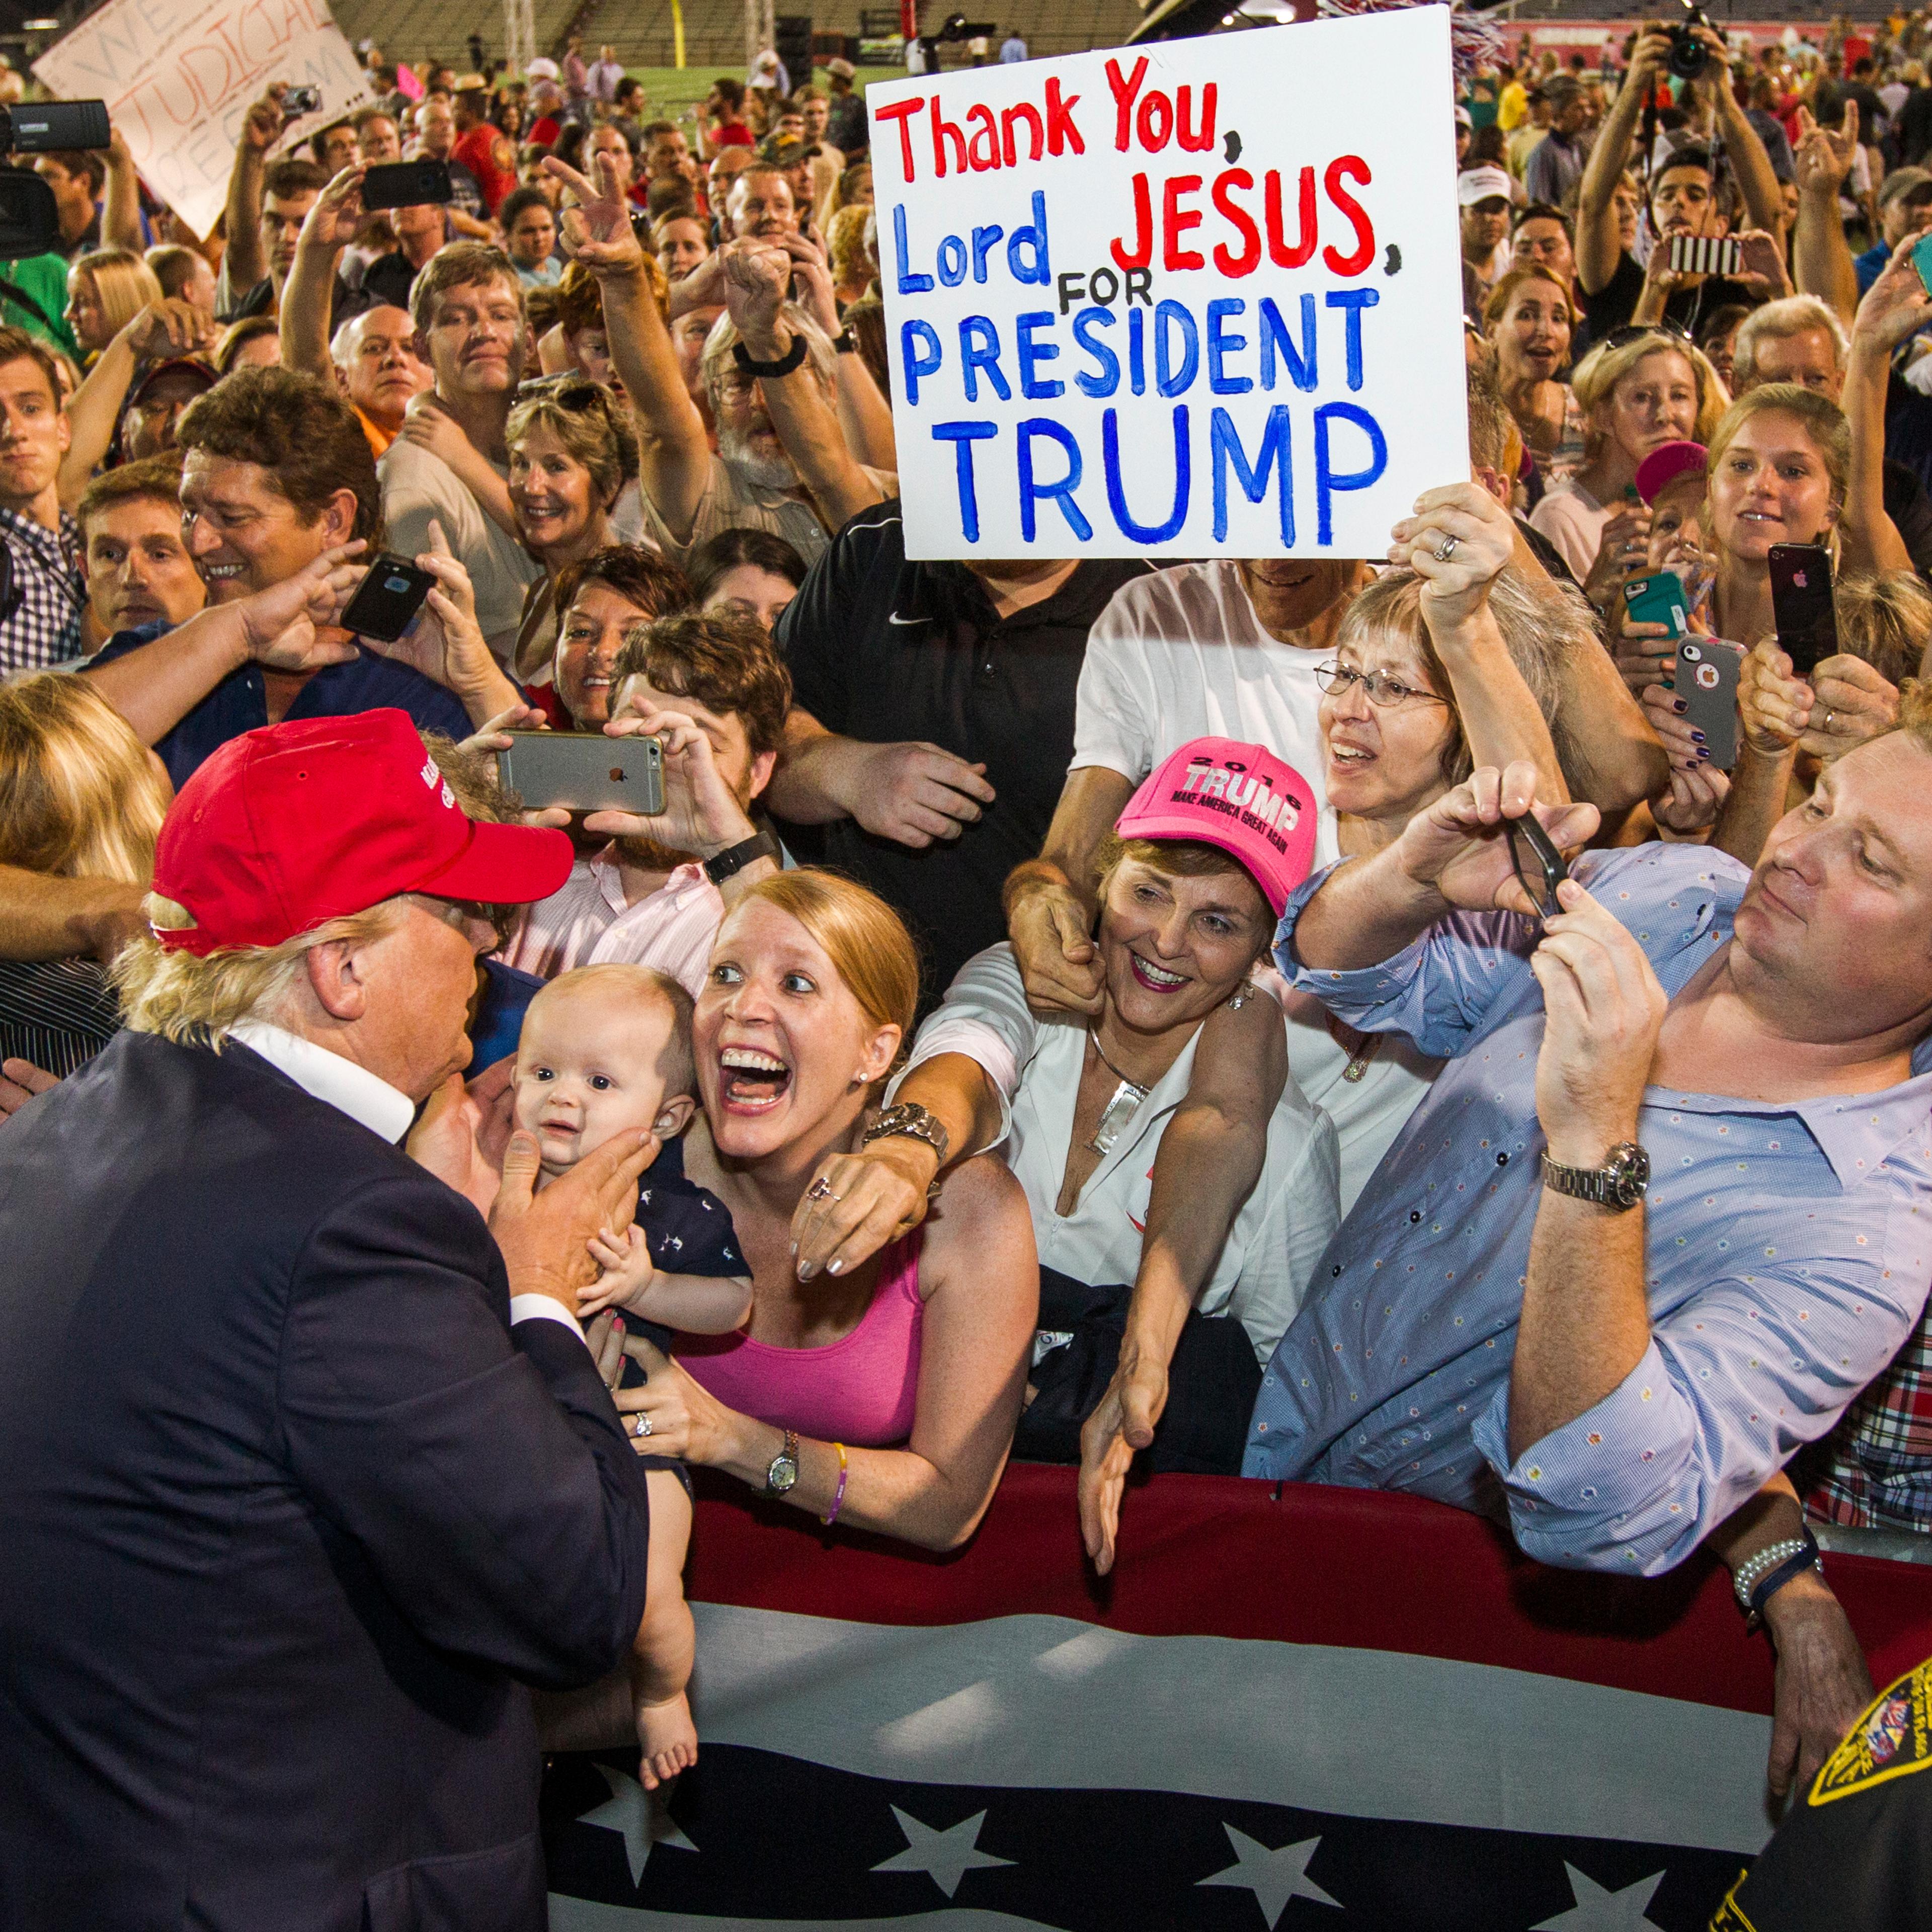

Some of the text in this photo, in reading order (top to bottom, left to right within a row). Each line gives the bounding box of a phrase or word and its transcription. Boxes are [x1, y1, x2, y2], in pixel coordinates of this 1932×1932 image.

[875, 55, 1243, 183] Thank You,
[893, 155, 1402, 295] Lord JESUS,
[901, 287, 1381, 407] PRESIDENT
[1058, 267, 1153, 315] FOR
[931, 400, 1389, 549] TRUMP
[1171, 790, 1288, 855] MAKE AMERICA GREAT AGAIN
[1182, 764, 1300, 833] TRUMP
